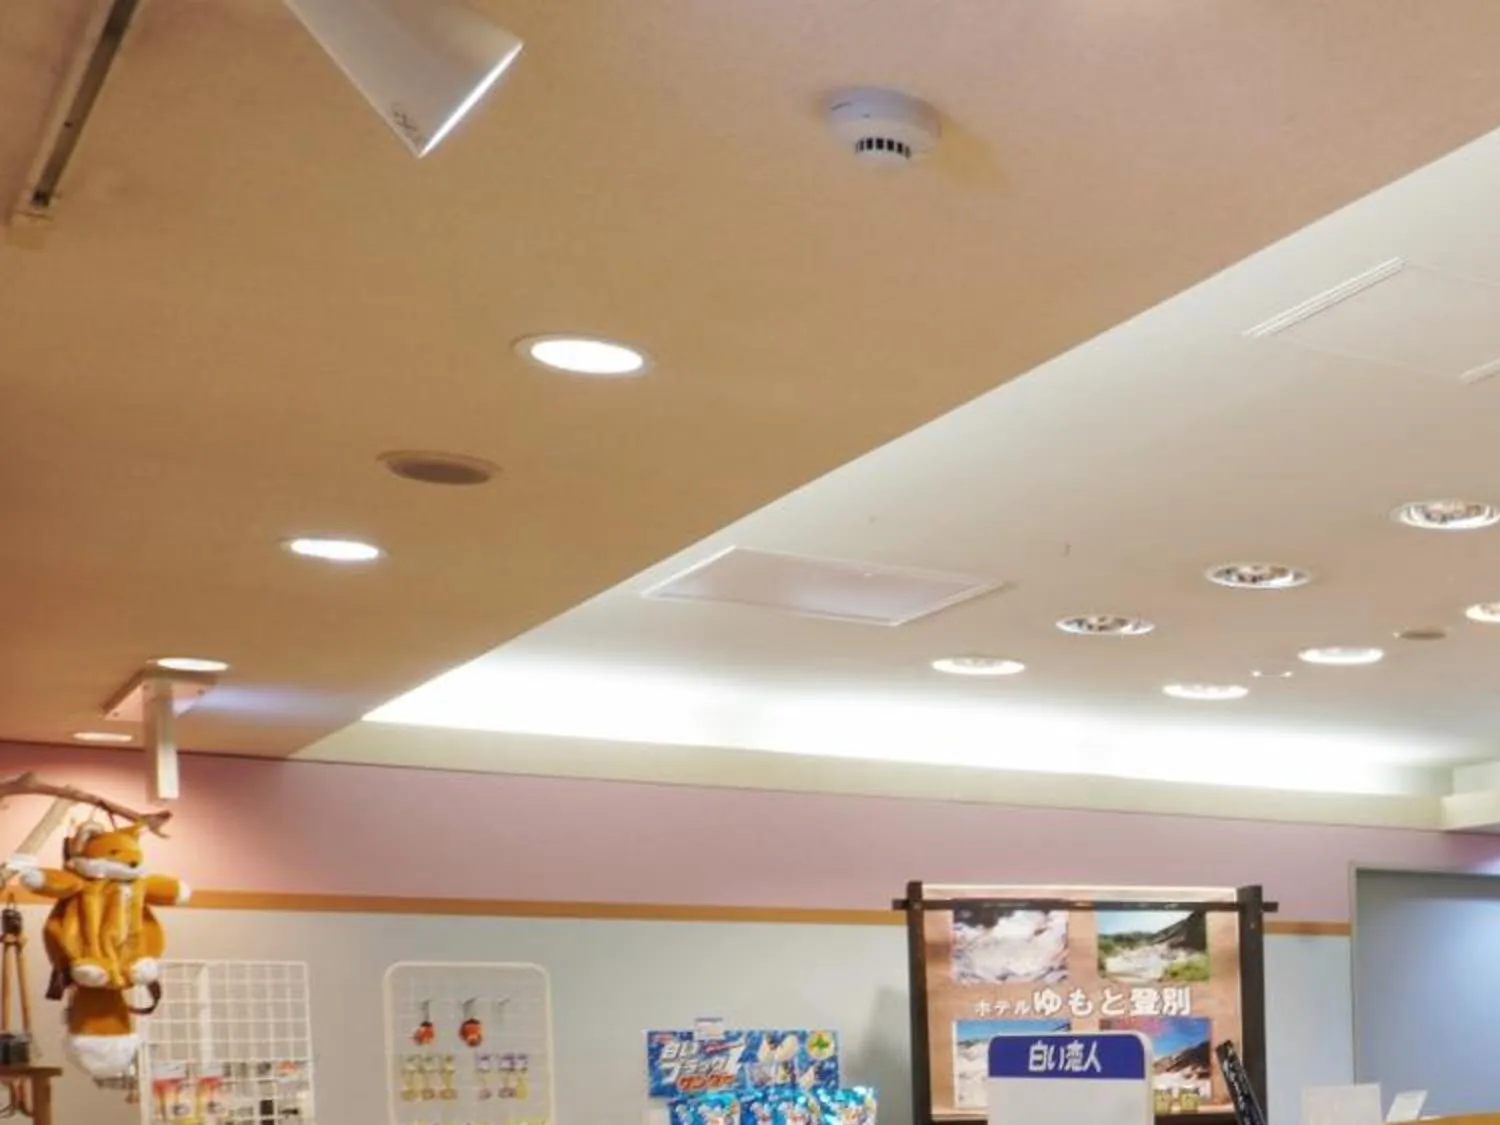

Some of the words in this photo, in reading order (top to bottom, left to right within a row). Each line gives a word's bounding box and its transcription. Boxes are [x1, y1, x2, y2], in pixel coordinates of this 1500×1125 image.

[974, 987, 1191, 1016] ホテルゆもと登別
[1028, 1040, 1102, 1073] 白い恋人
